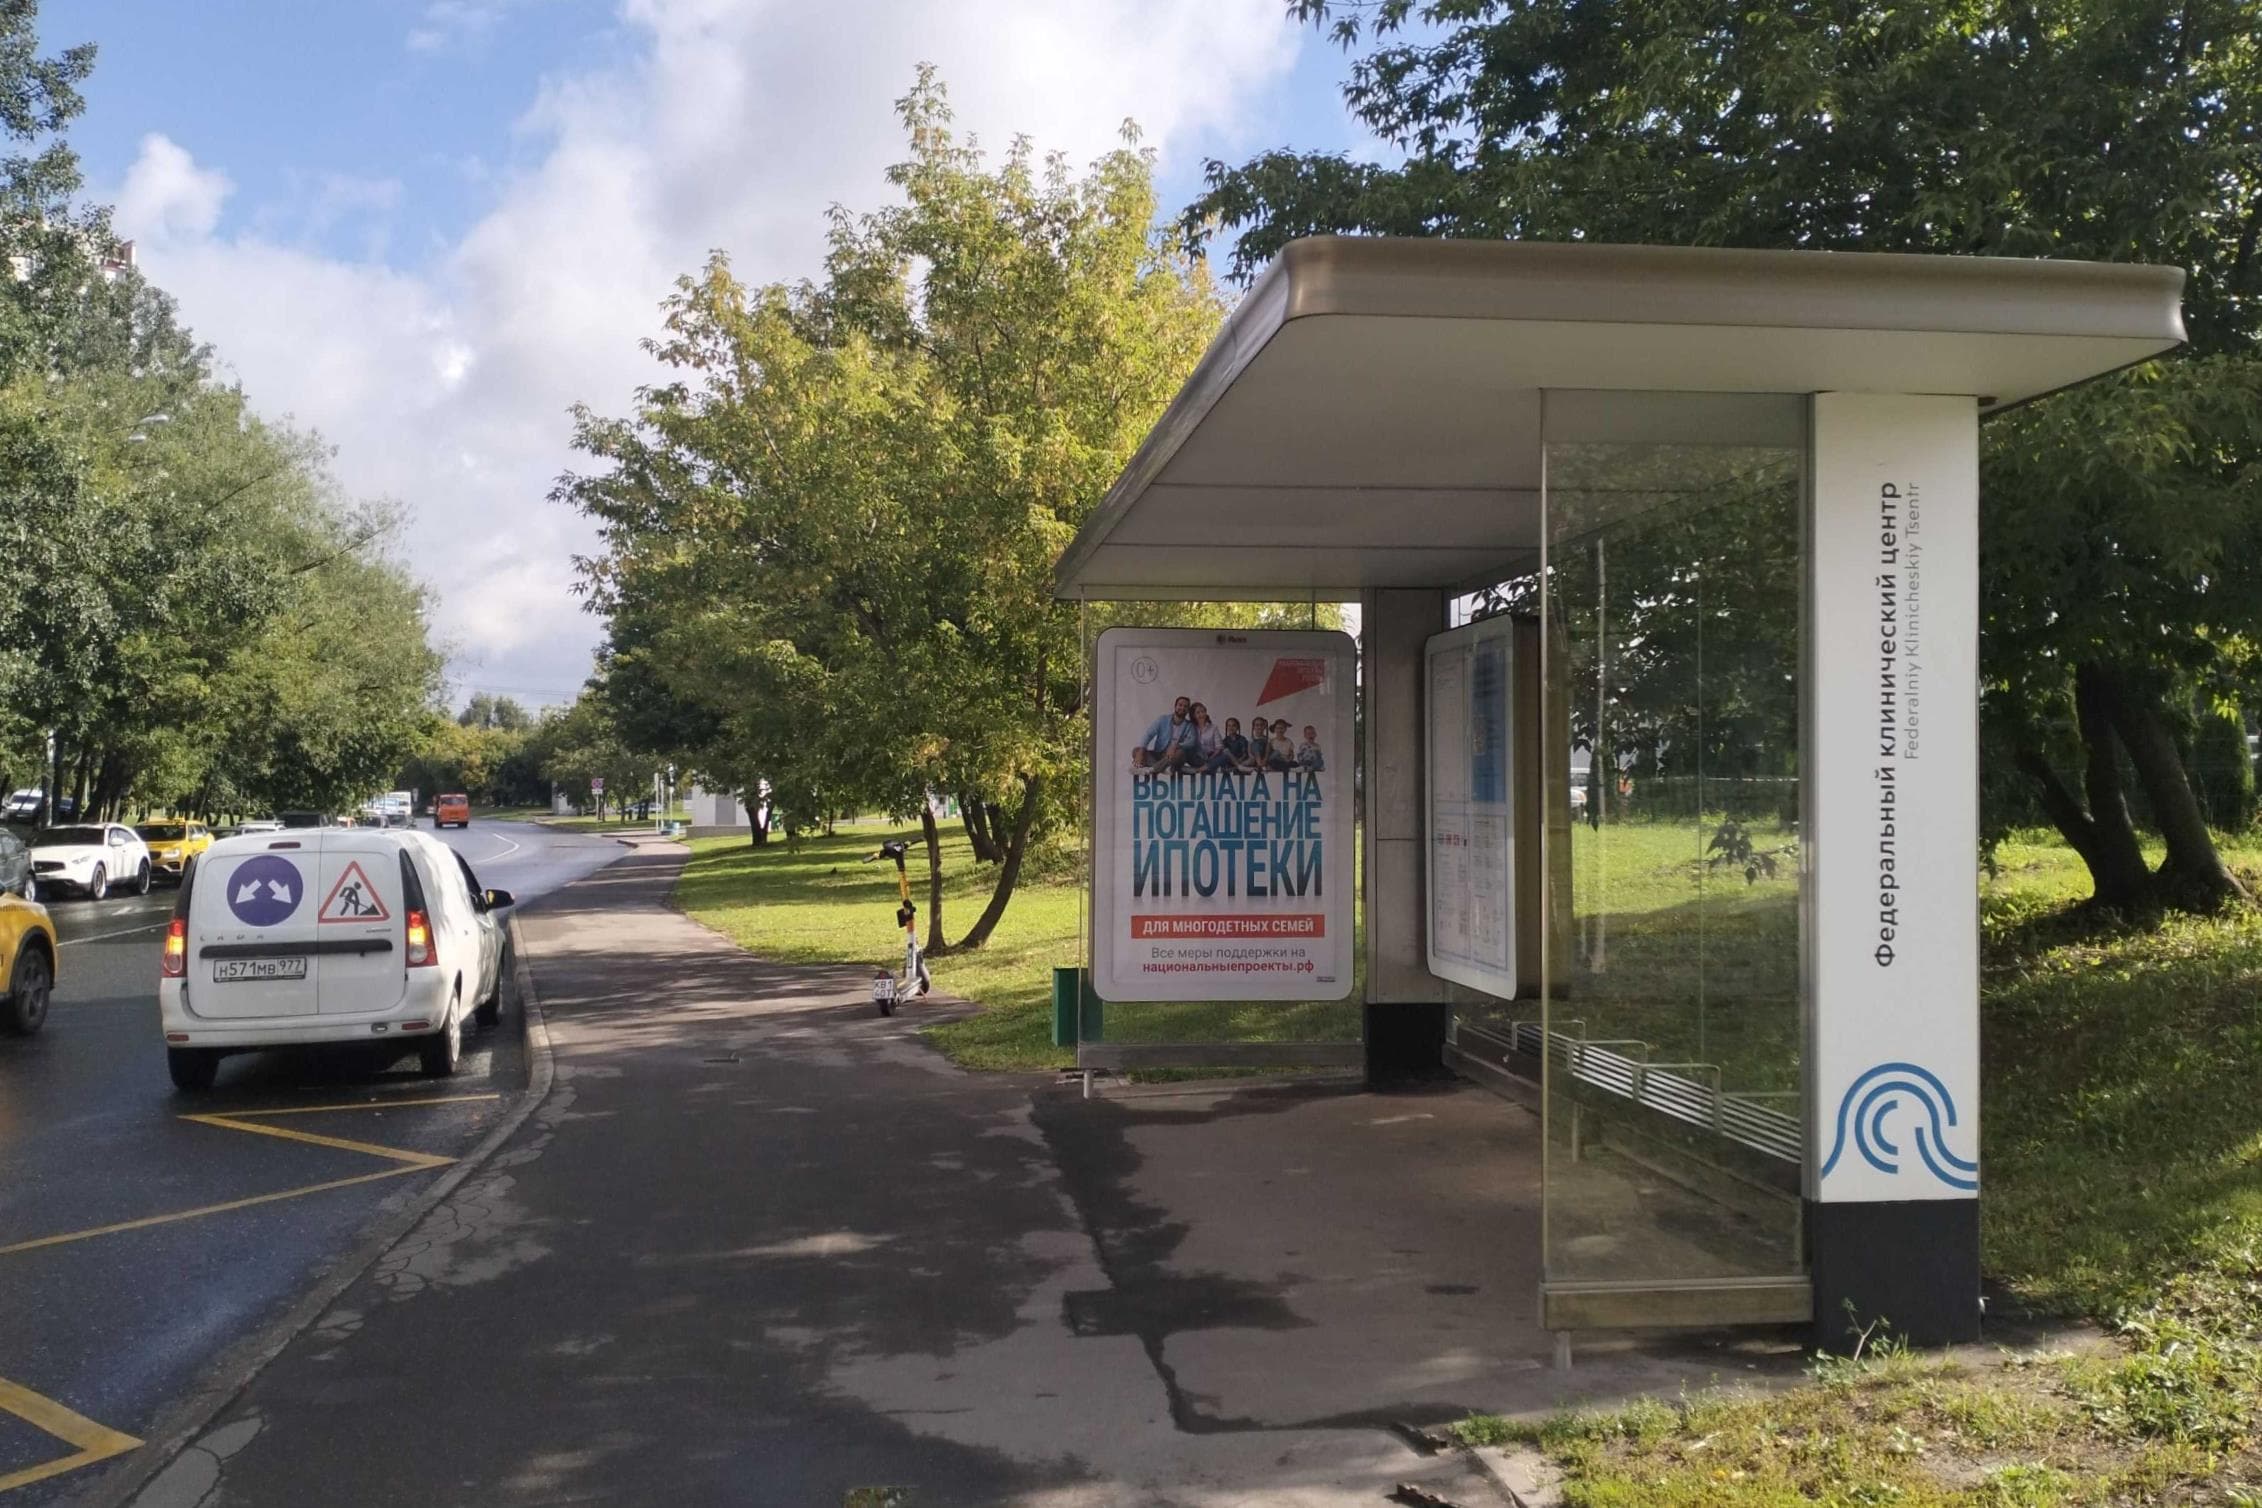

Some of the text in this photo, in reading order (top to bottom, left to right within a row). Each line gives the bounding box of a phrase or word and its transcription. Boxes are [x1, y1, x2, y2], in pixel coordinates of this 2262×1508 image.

[1903, 482, 1923, 759] Federalniy Klinicheskiy Tsentr
[1136, 661, 1155, 678] 0+
[1874, 482, 1902, 968] Федеральный клинический центр
[1133, 771, 1322, 800] ВЫПЛАТА НА
[1133, 801, 1322, 839] ПОГАШЕНИЕ
[1133, 839, 1322, 897] ИПОТЕКИ
[1143, 917, 1314, 935] ДЛЯ МНОГОДЕТНЫХ СЕМЕЙ
[1143, 960, 1314, 974] национальныепроекты.рф
[1151, 947, 1306, 961] Все меры поддержки на
